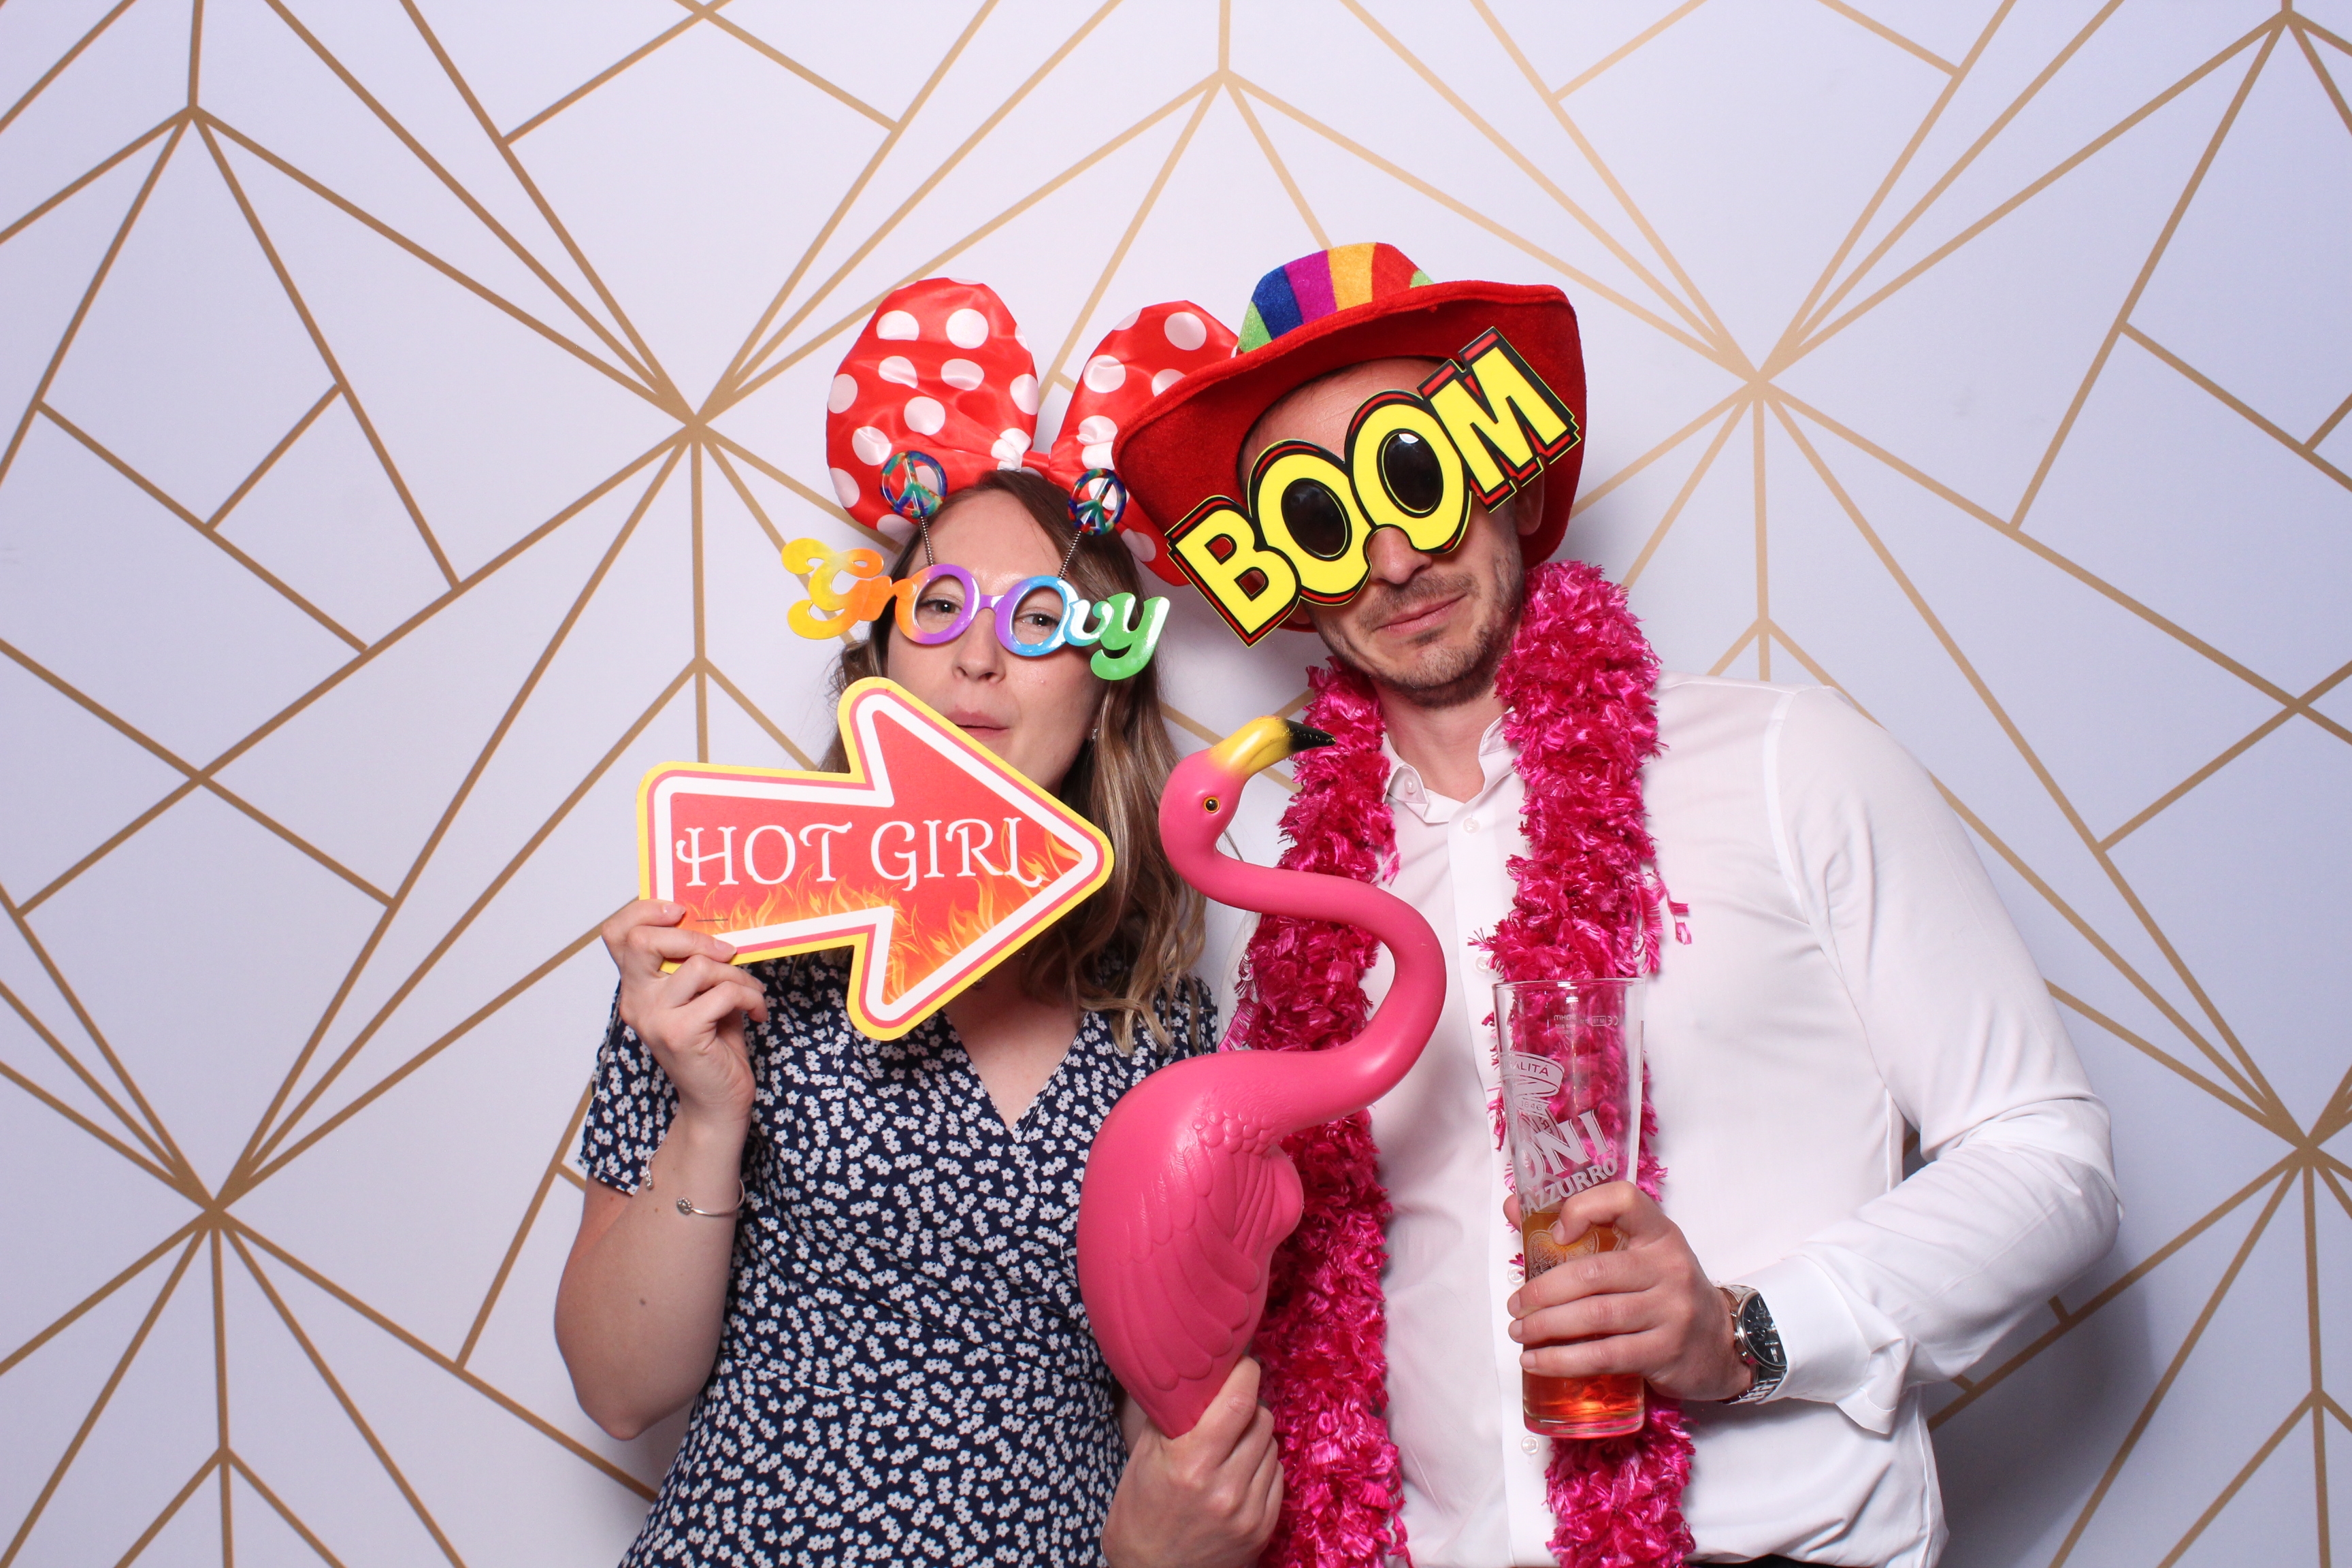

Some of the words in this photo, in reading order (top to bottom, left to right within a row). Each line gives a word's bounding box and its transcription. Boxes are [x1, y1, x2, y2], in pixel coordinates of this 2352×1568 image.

[1166, 327, 1580, 647] BOOM
[676, 821, 853, 886] HOT
[870, 817, 1043, 892] GIRL
[1520, 1100, 1542, 1111] 1846
[1514, 1109, 1611, 1186] ONI
